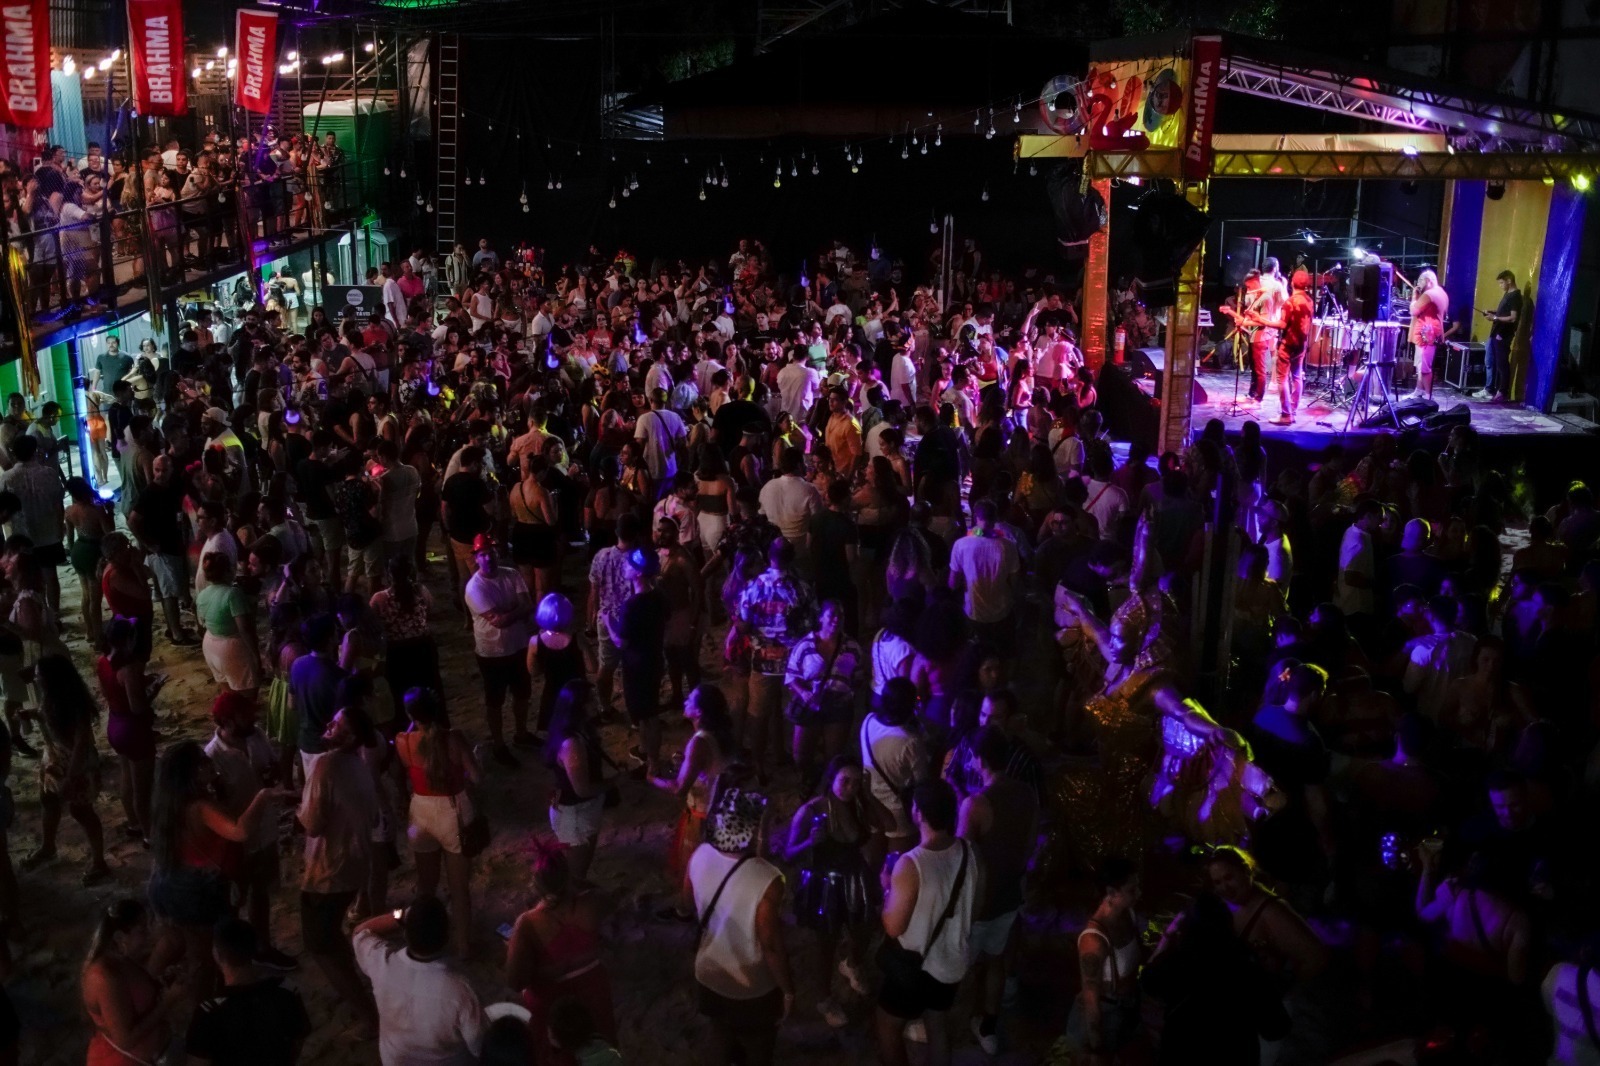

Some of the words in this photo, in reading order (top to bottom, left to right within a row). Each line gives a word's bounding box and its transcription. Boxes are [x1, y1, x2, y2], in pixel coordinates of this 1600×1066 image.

[3, 4, 38, 112] BRAHMA
[145, 15, 173, 104] BRAHMA
[243, 26, 266, 99] BRAHMA
